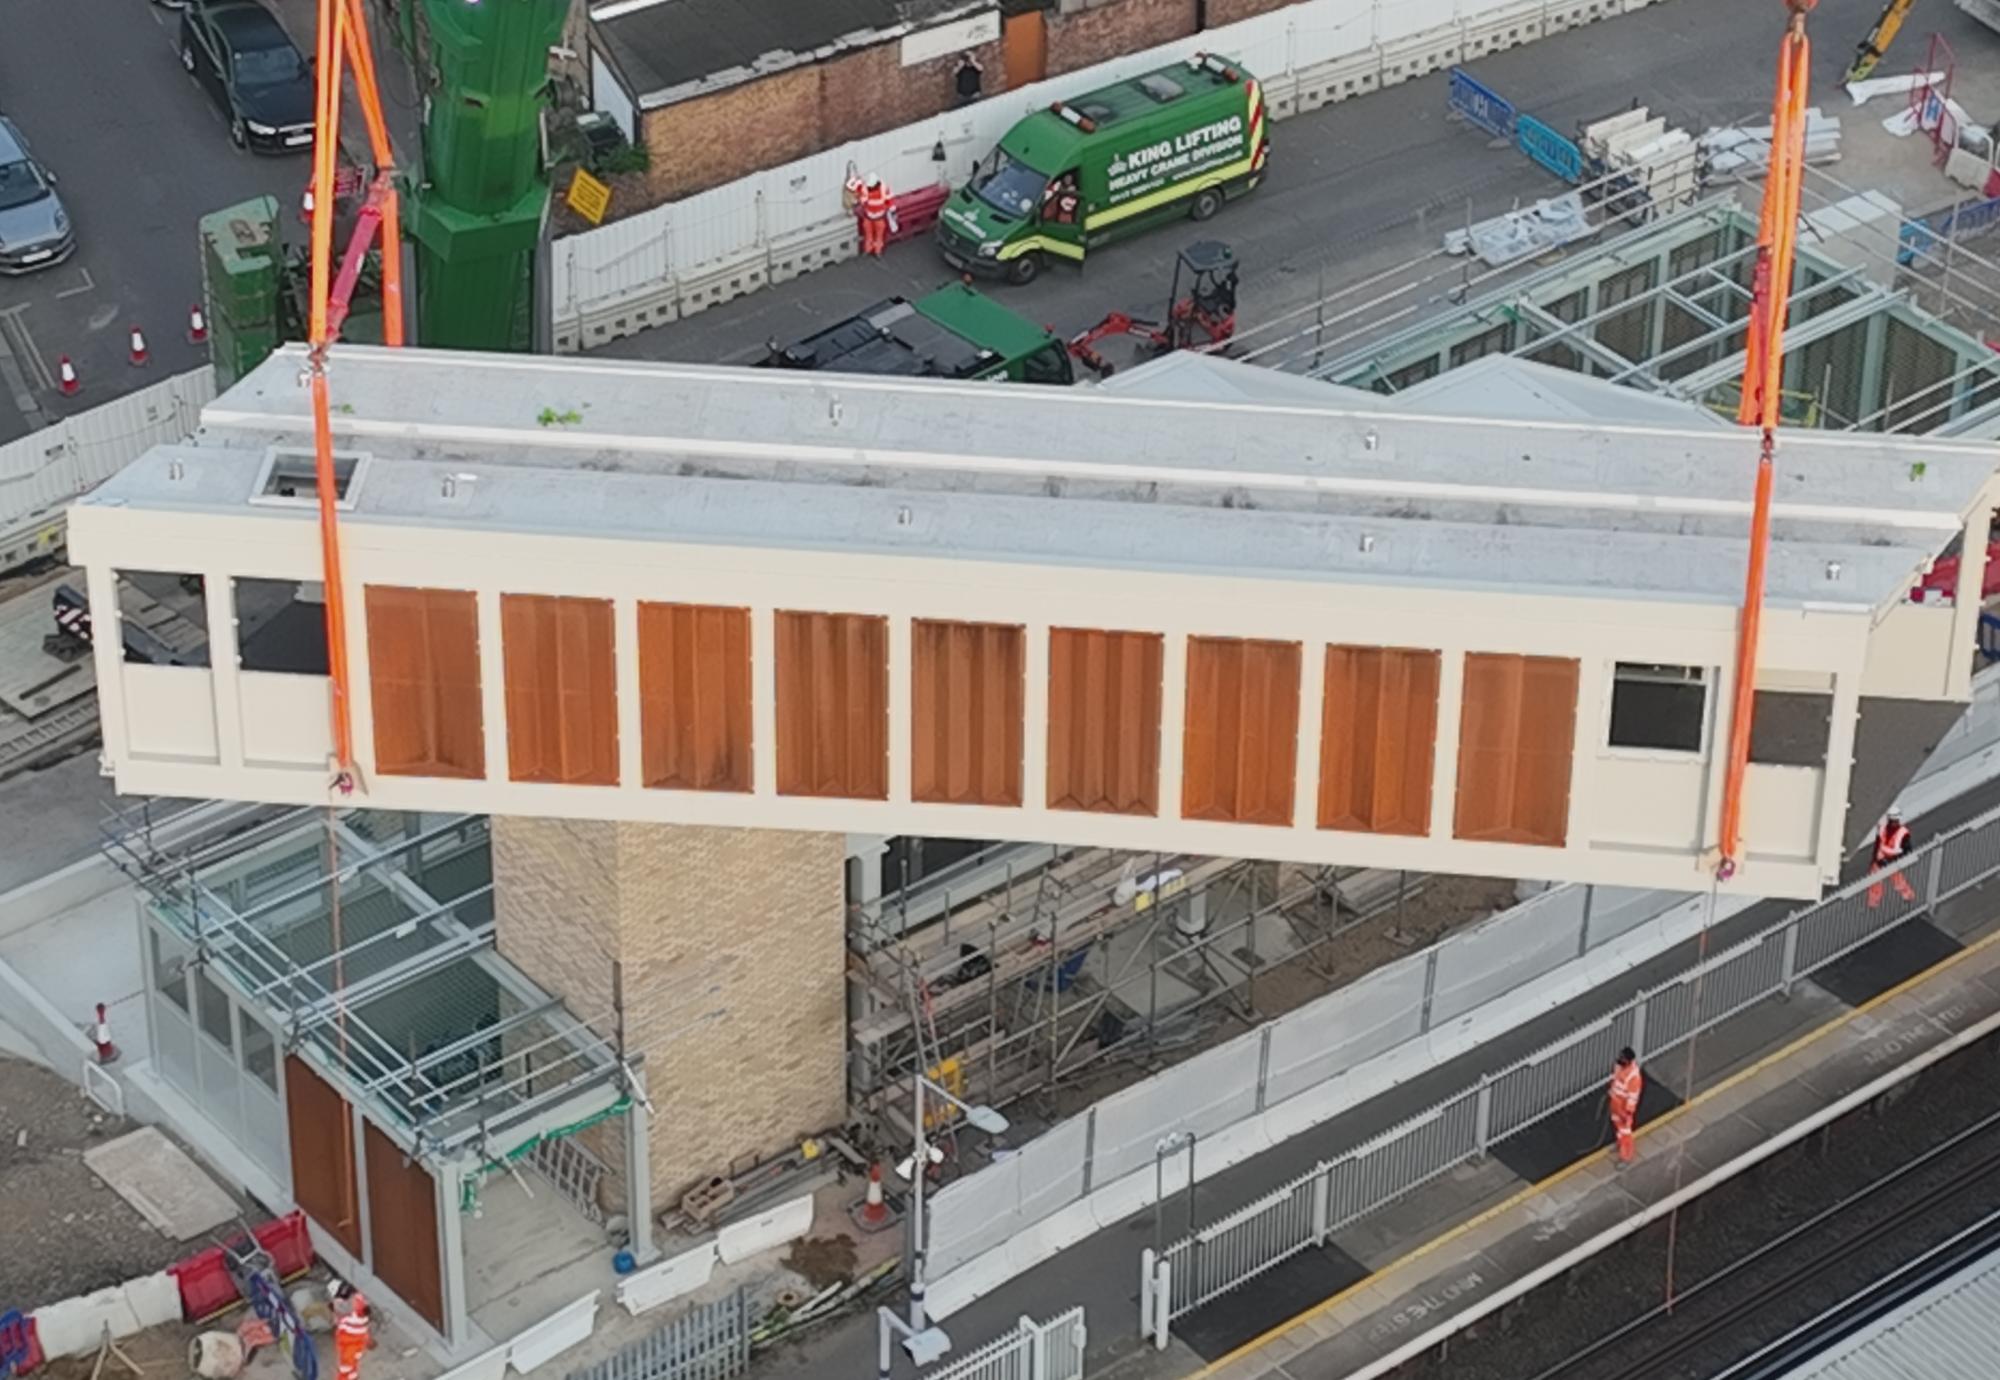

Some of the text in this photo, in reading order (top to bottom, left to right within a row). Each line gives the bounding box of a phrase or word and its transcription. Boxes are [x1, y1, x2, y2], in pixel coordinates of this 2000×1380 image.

[1109, 168, 1149, 191] HEAVY
[1150, 153, 1190, 176] CRANE
[1192, 134, 1243, 160] DIVISION
[1128, 141, 1172, 169] KING
[1175, 115, 1241, 152] LIFTING
